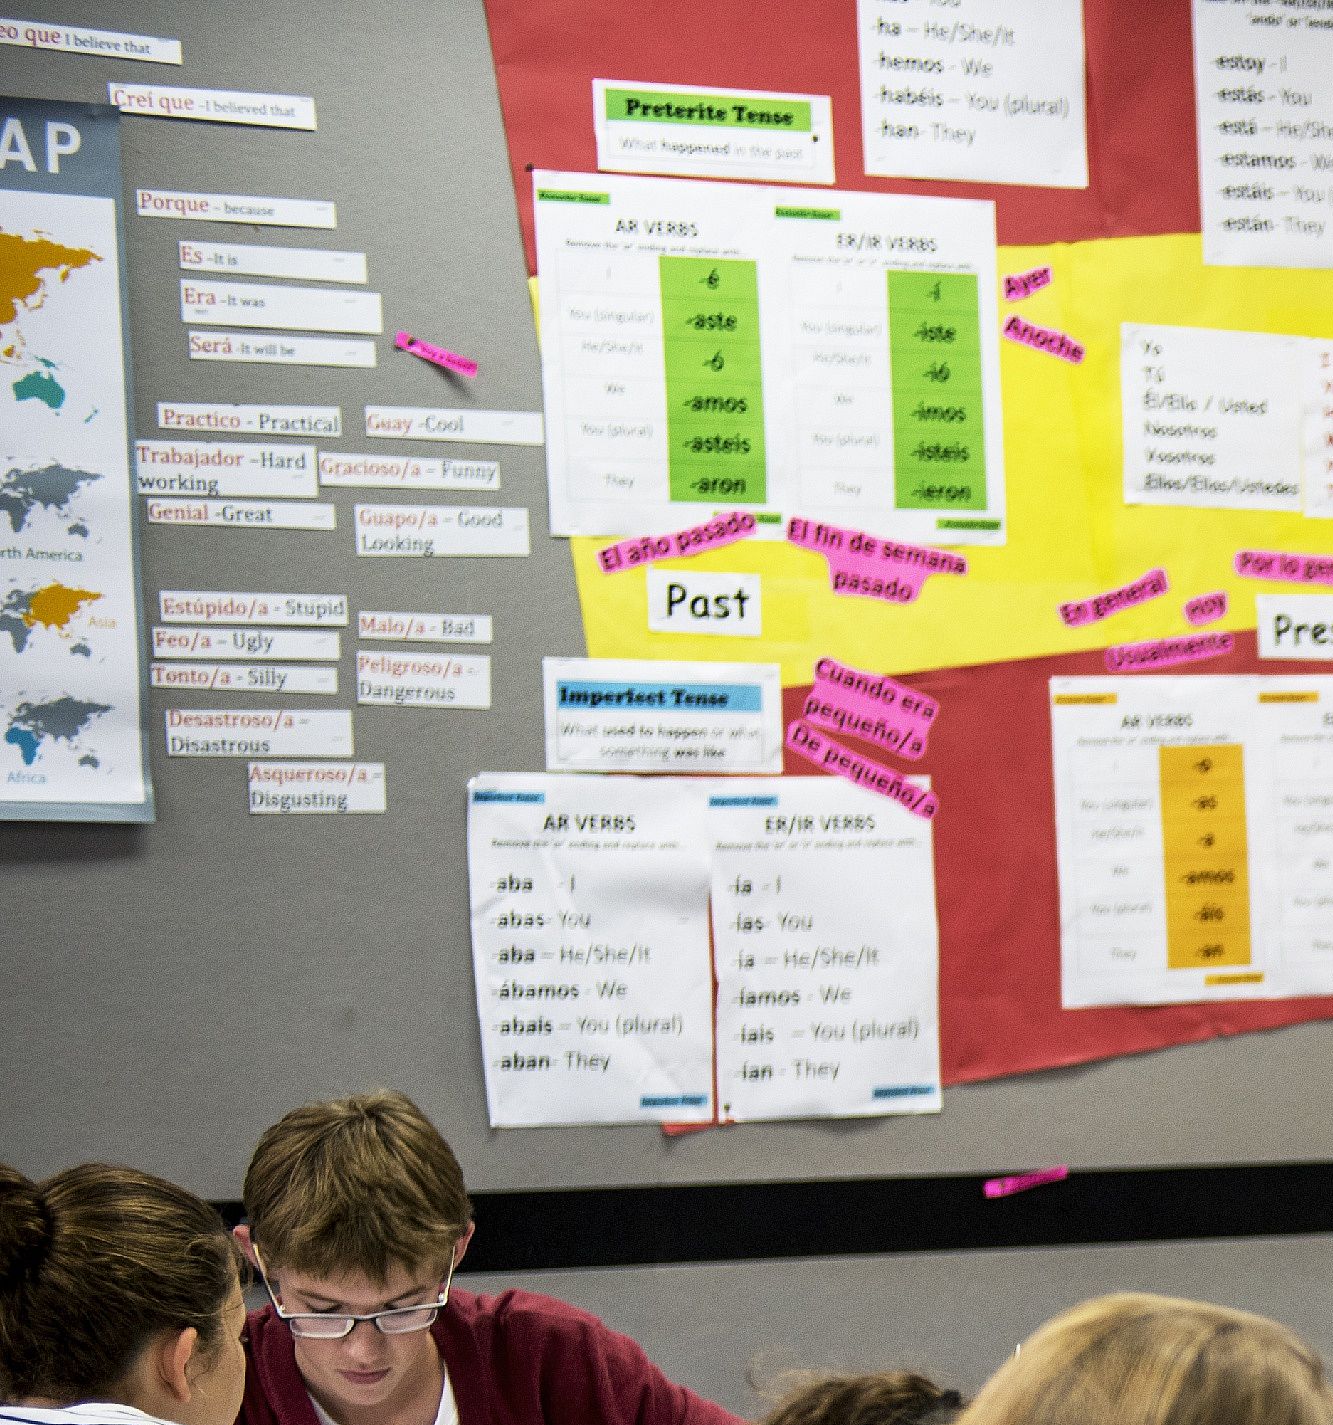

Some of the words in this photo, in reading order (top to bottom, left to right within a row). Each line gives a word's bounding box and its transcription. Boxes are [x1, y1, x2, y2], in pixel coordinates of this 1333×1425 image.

[24, 27, 62, 47] que
[65, 35, 71, 45] I
[74, 35, 121, 52] believe
[124, 41, 151, 55] that
[114, 89, 155, 108] Creí
[158, 95, 194, 114] que
[213, 100, 268, 117] believed
[270, 105, 295, 117] that
[626, 98, 726, 124] Preterite
[733, 104, 794, 127] Tense
[139, 192, 209, 216] Porque
[224, 203, 275, 218] because
[615, 218, 640, 235] AR
[644, 219, 699, 238] VERBS
[883, 233, 938, 253] VERBS
[180, 246, 202, 265] Es
[227, 254, 238, 266] is
[1004, 268, 1051, 300] Ayer
[184, 287, 216, 307] Era
[239, 296, 266, 309] was
[190, 334, 232, 356] Será
[254, 343, 277, 357] will
[280, 343, 295, 357] be
[1004, 317, 1085, 363] Anoche
[163, 409, 241, 430] Practico
[258, 413, 340, 434] Practical
[366, 414, 411, 434] Guay
[137, 445, 245, 470] Trabajador
[320, 456, 421, 479] Gracioso/a
[441, 462, 497, 484] Funny
[138, 473, 218, 495] working
[149, 503, 208, 522] Genial
[359, 509, 438, 531] Guapo/a
[457, 510, 503, 529] Good
[361, 534, 434, 555] Looking
[600, 548, 623, 572] El
[628, 534, 671, 565] año
[676, 512, 756, 556] pasado
[787, 518, 809, 541] El
[813, 523, 844, 548] fin
[849, 531, 877, 554] de
[882, 540, 967, 575] semana
[25, 547, 83, 564] America
[833, 570, 914, 602] pasado
[162, 597, 268, 620] Estúpido/a
[285, 598, 344, 619] Stupid
[666, 582, 750, 620] Past
[88, 617, 117, 630] Asia
[359, 617, 425, 637] Malo/a
[441, 619, 475, 637] Bad
[155, 631, 211, 651] Feo/a
[232, 633, 274, 655] Ugly
[358, 655, 463, 679] Peligroso/a
[153, 667, 231, 687] Tonto/a
[247, 668, 287, 691] Silly
[815, 658, 897, 704] Cuando
[898, 693, 936, 719] era
[358, 680, 455, 704] Dangerous
[558, 687, 668, 710] Imperfect
[673, 688, 729, 709] Tense
[168, 710, 295, 731] Desastroso/a
[805, 697, 924, 754] pequeño/a
[170, 735, 270, 755] Disastrous
[7, 770, 47, 785] Africa
[249, 763, 368, 786] Asqueroso/a
[792, 725, 821, 751] De
[823, 742, 937, 818] pequeño/a
[250, 789, 348, 812] Disgusting
[543, 815, 569, 832] AR
[575, 815, 635, 833] VERBS
[820, 814, 875, 833] VERBS
[558, 912, 591, 929] You
[596, 982, 628, 999] We
[577, 1016, 609, 1034] You
[564, 1051, 610, 1073] They
